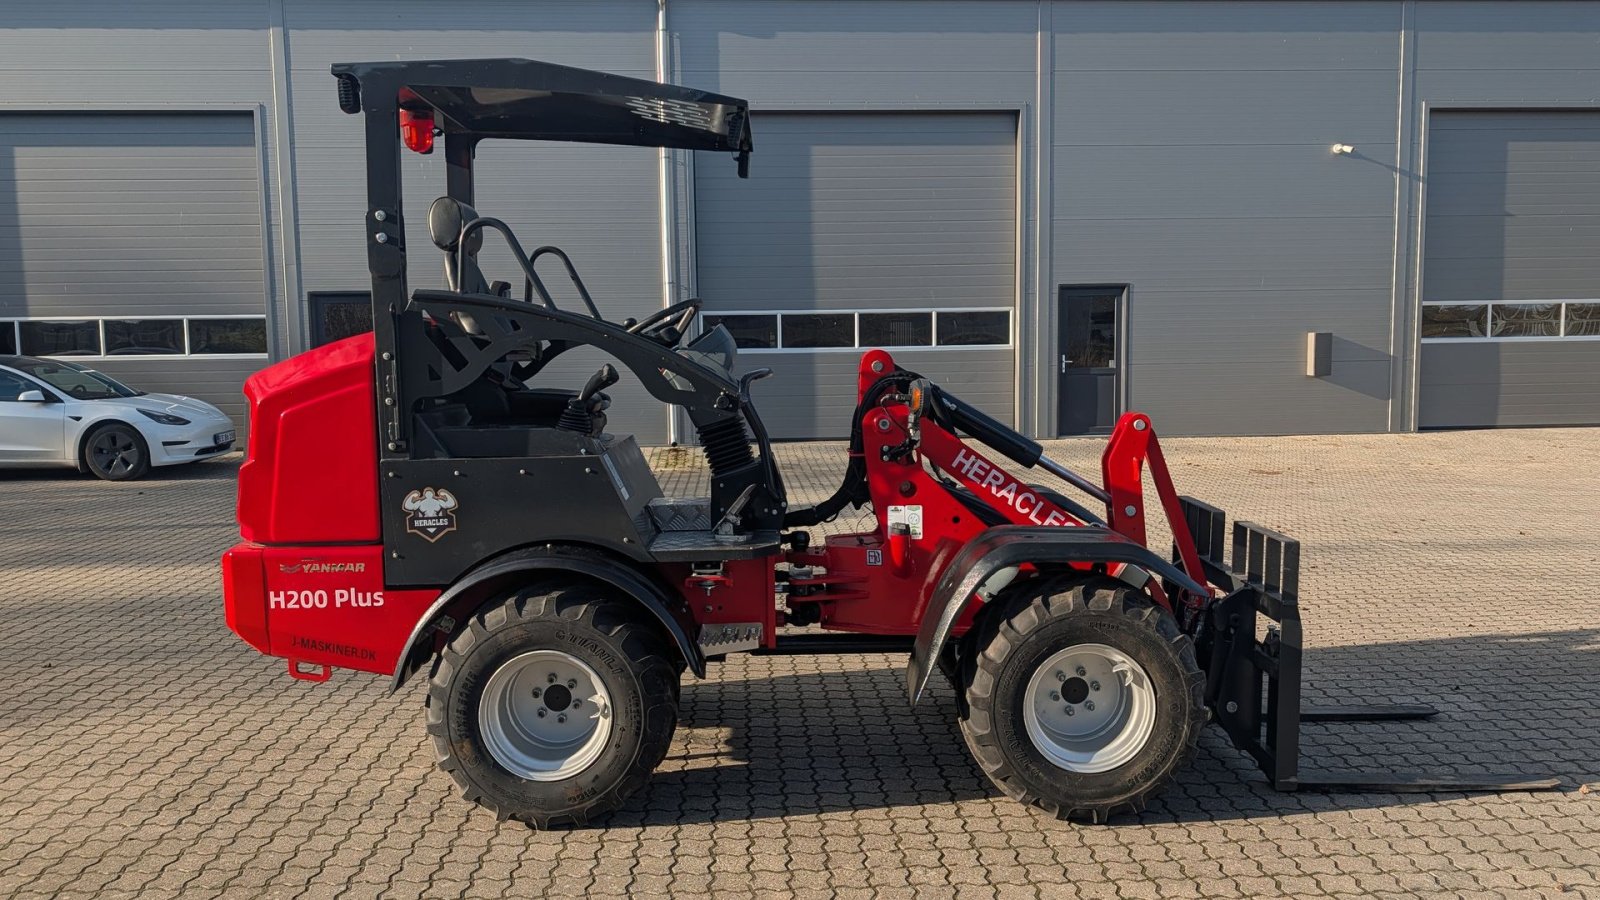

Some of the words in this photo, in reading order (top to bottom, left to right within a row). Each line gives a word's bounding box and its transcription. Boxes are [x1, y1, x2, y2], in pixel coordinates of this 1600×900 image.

[414, 518, 449, 527] HERACLES
[302, 563, 365, 573] YANMAR
[269, 590, 328, 609] H200
[334, 587, 384, 607] Plus
[291, 635, 376, 660] J-MASKINER.DK
